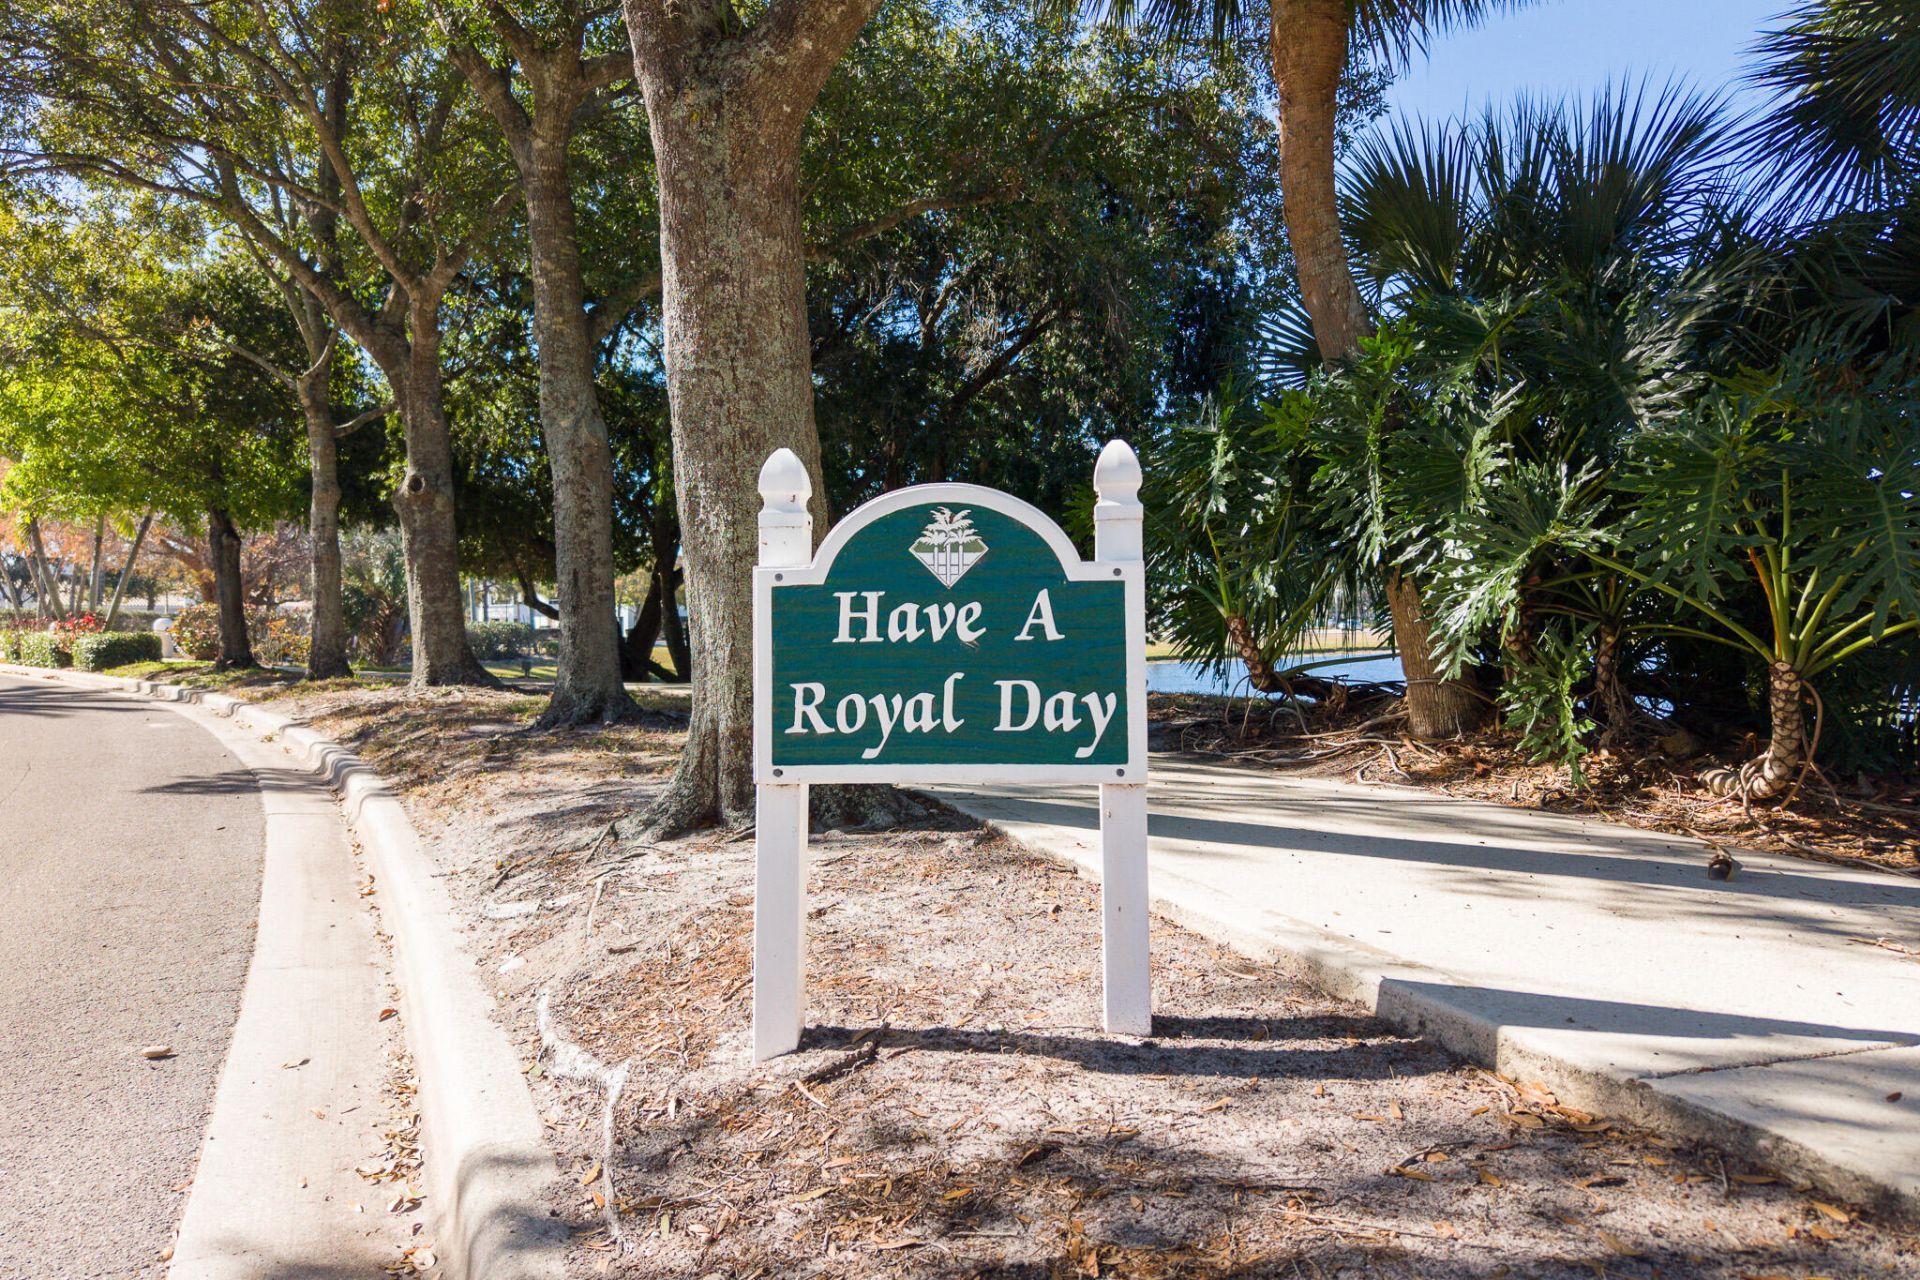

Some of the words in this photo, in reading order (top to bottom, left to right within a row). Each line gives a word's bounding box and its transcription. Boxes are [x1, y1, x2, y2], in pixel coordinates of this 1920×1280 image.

[832, 591, 987, 644] Have
[1014, 588, 1066, 641] A
[784, 672, 965, 759] Royal
[993, 679, 1117, 758] Day
